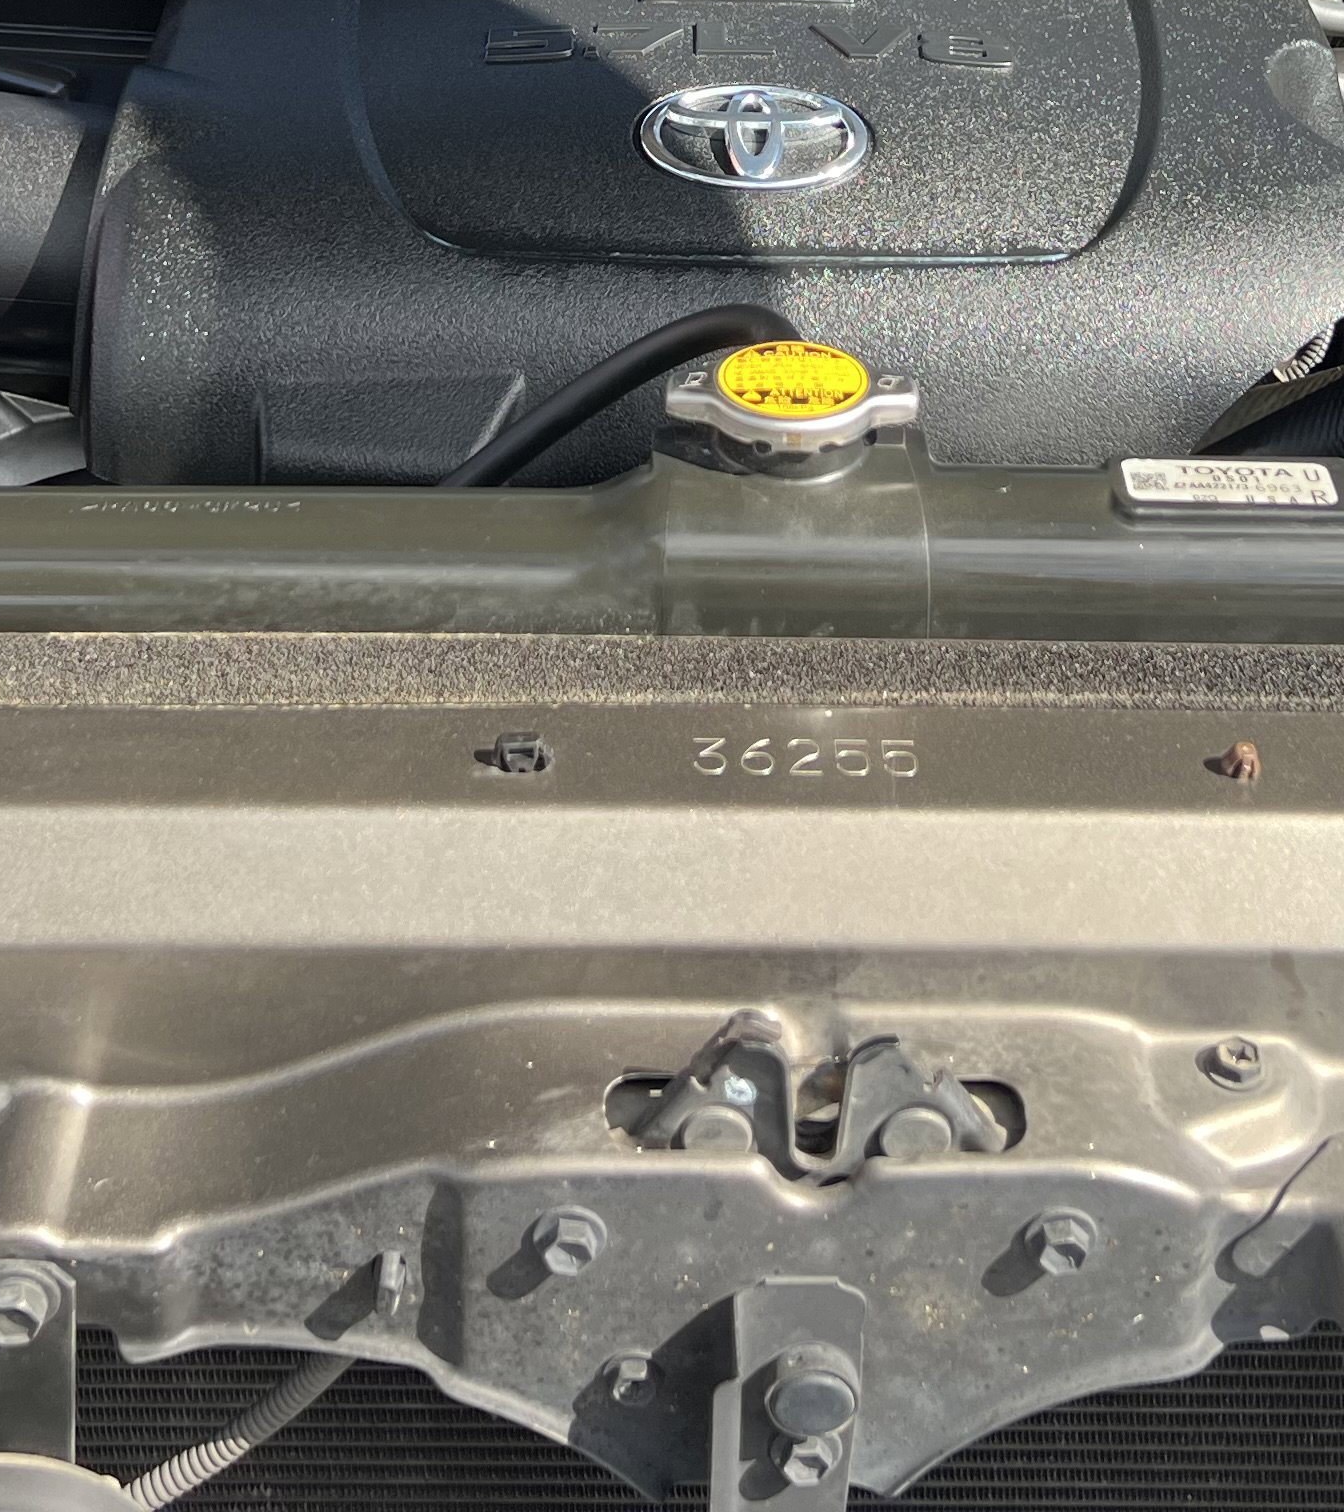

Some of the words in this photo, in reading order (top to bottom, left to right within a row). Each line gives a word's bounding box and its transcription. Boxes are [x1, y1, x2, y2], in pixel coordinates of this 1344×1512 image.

[807, 24, 1015, 70] V8
[763, 350, 832, 359] CAUTION
[770, 387, 844, 400] ATTENTION
[1175, 465, 1293, 477] TOYOTA
[692, 737, 920, 778] 36255
